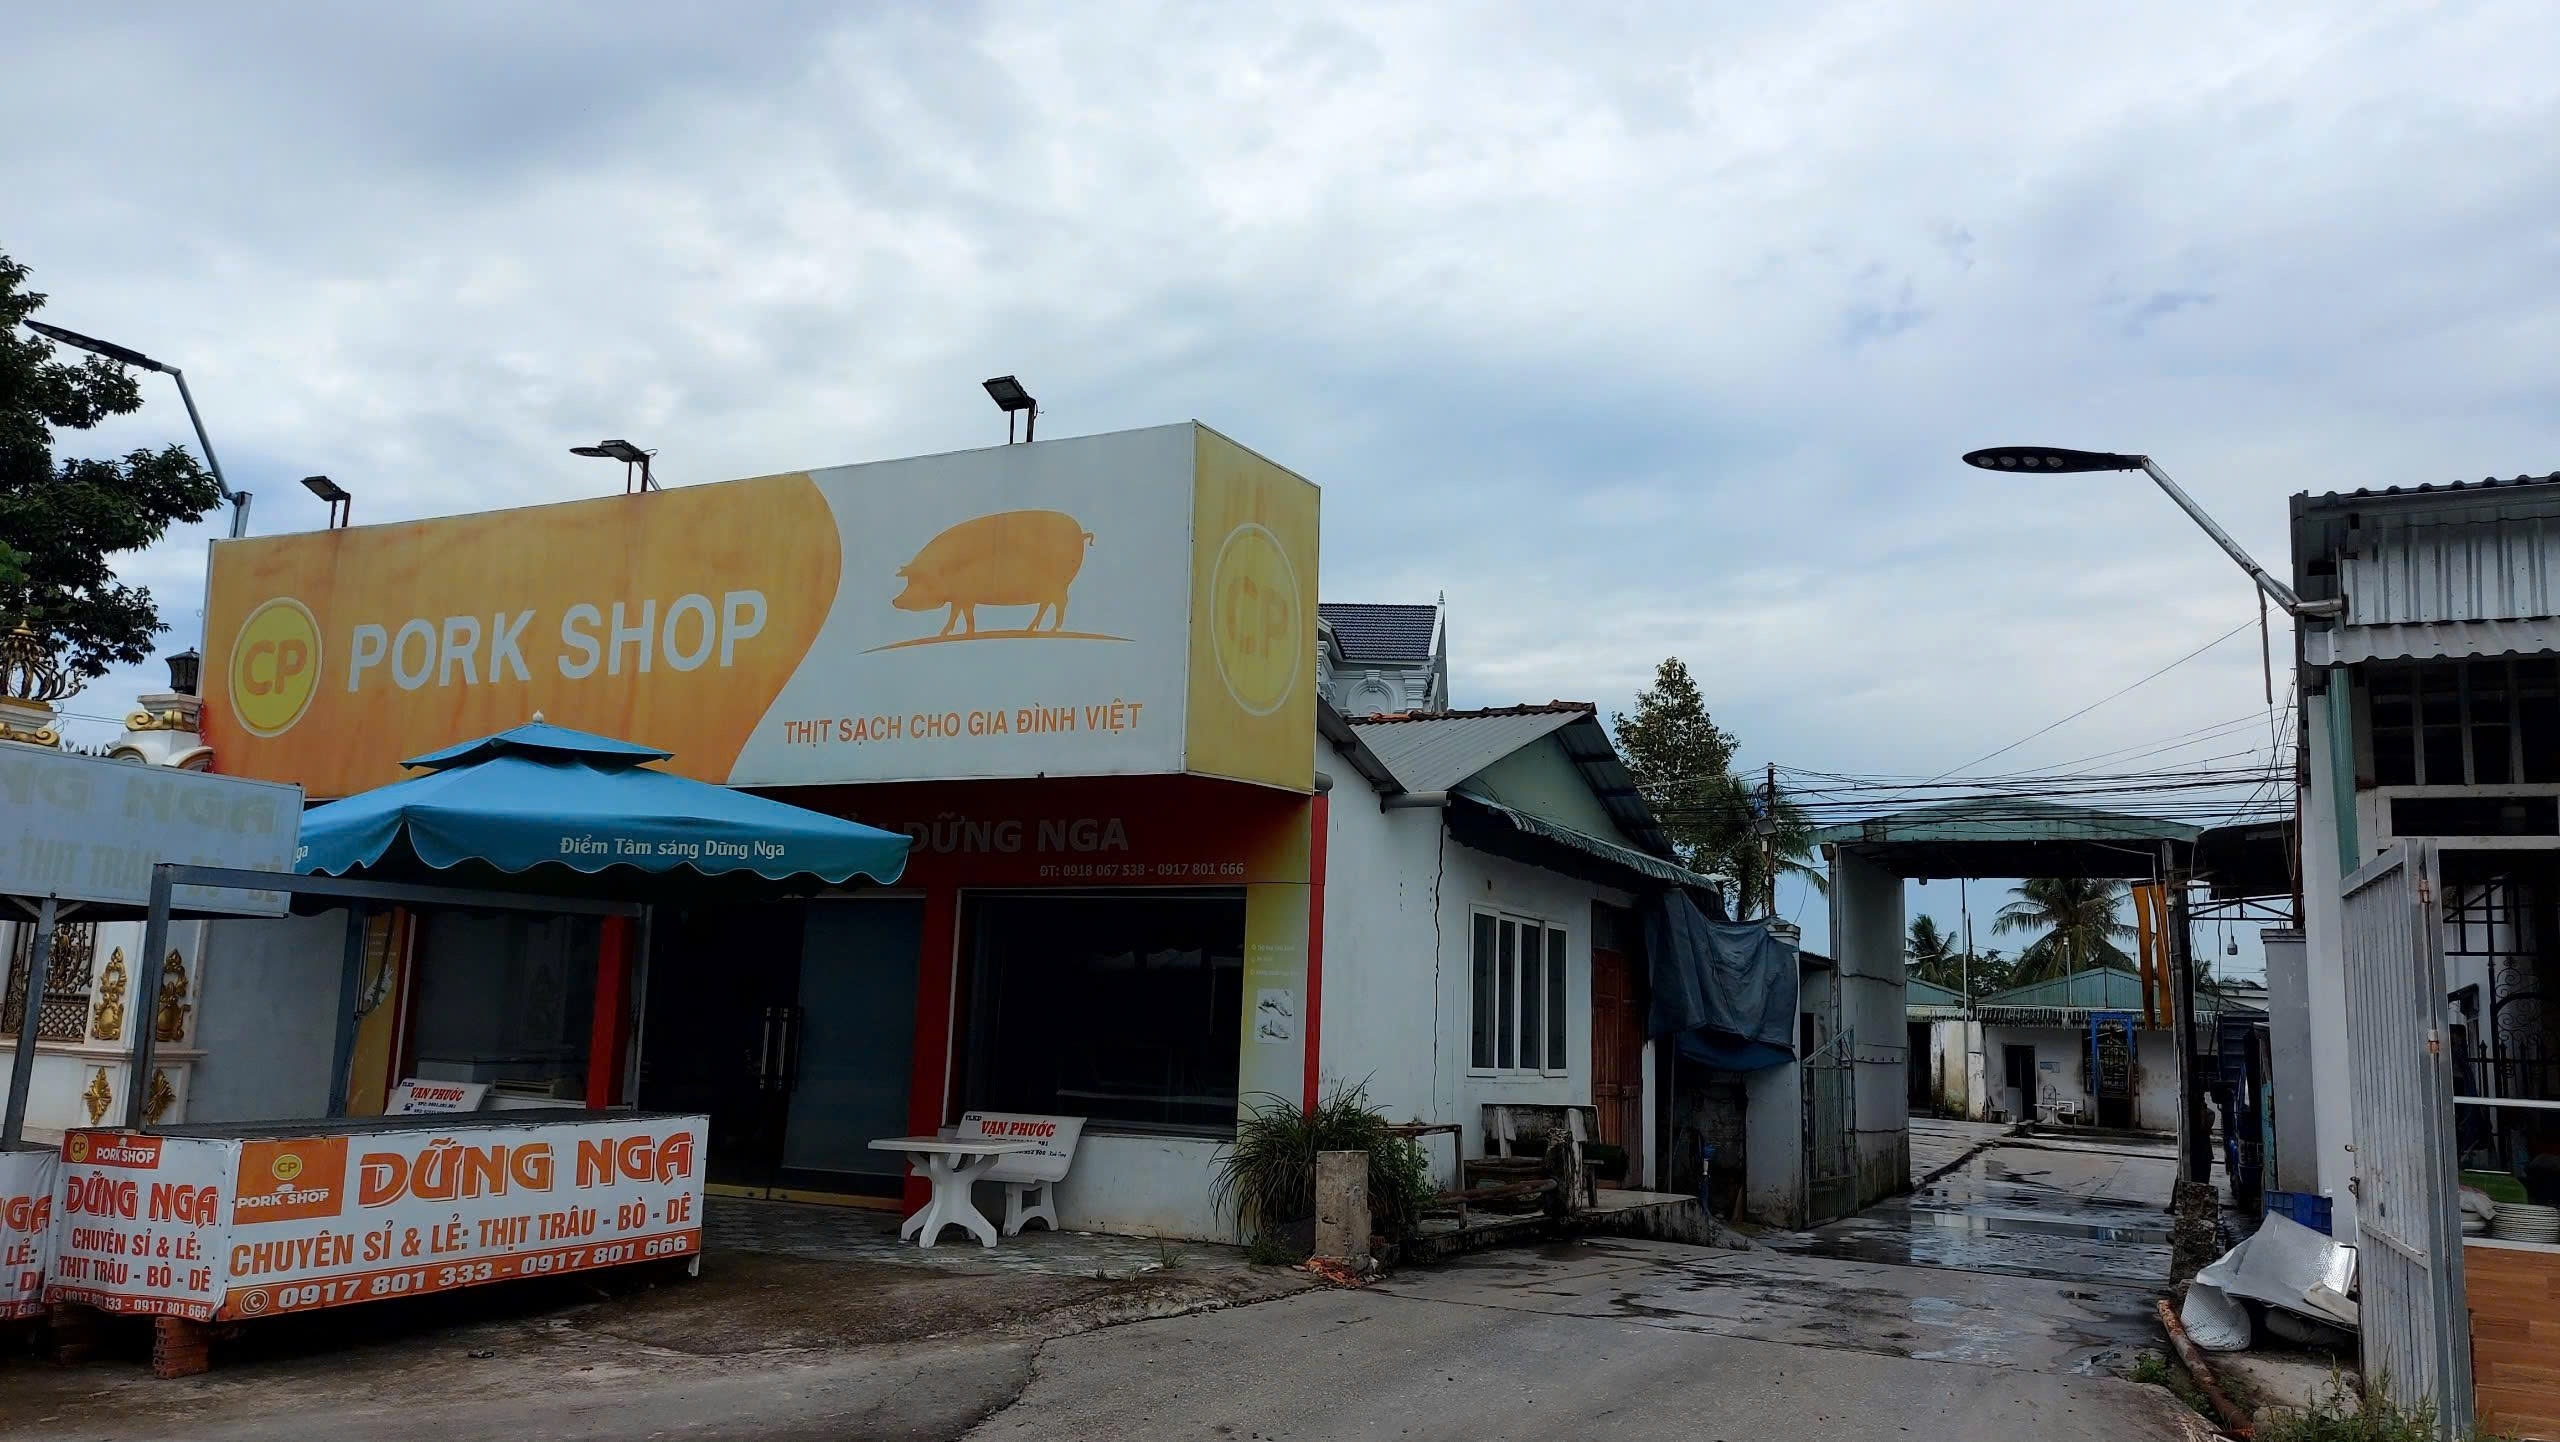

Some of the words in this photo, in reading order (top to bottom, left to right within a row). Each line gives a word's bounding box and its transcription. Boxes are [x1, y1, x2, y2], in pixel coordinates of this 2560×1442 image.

[347, 609, 536, 693] PORK
[558, 589, 768, 680] SHOP
[242, 639, 308, 696] CP
[785, 719, 832, 748] THỊT
[839, 715, 902, 746] SẠCH
[910, 712, 961, 740] CHO
[968, 710, 1008, 736] GIA
[1016, 702, 1076, 734] ĐÌNH
[1085, 697, 1143, 735] VIỆT
[560, 834, 608, 855] Điểm
[614, 838, 652, 855] Tâm
[658, 840, 700, 859] sáng
[754, 841, 785, 859] Nga
[903, 812, 1024, 853] DỮNG
[1037, 817, 1130, 853] NGA
[295, 845, 308, 863] ga
[1063, 863, 1093, 877] 0918
[1096, 863, 1119, 877] 067
[1157, 863, 1189, 876] 0917
[1192, 863, 1216, 876] 801
[1220, 862, 1245, 876] 666
[72, 1141, 86, 1153] CP
[96, 1146, 121, 1162] PORK
[121, 1149, 156, 1164] SHOP
[277, 1162, 298, 1173] CP
[358, 1137, 555, 1209] DỮNG
[576, 1131, 695, 1189] NGA
[0, 1194, 52, 1235] GA
[66, 1170, 139, 1220] DỮNG
[149, 1182, 220, 1229] NGA
[237, 1195, 282, 1209] PORK
[288, 1191, 329, 1204] SHOP
[5, 1237, 38, 1266] LẺ:
[72, 1227, 127, 1255] CHUYÊN
[132, 1227, 152, 1257] SỈ
[156, 1236, 170, 1258] &
[176, 1231, 202, 1261] LẺ:
[231, 1230, 355, 1277] CHUYÊN
[363, 1220, 393, 1262] SỈ
[401, 1227, 422, 1257] &
[431, 1213, 469, 1253] LẺ:
[478, 1215, 531, 1251] THỊT
[538, 1205, 596, 1241] TRÂU
[618, 1197, 646, 1231] BÒ
[667, 1192, 692, 1224] DÊ
[59, 1255, 90, 1283] THỊT
[94, 1258, 129, 1285] TRÂU
[147, 1261, 172, 1288] BÒ
[189, 1265, 212, 1292] DÊ
[278, 1279, 361, 1308] 0917
[370, 1271, 426, 1295] 801
[438, 1263, 493, 1287] 333
[521, 1250, 586, 1275] 0917
[593, 1243, 635, 1265] 801
[644, 1236, 688, 1256] 666
[134, 1299, 164, 1313] 0917
[167, 1301, 186, 1315] 801
[188, 1304, 207, 1318] 666
